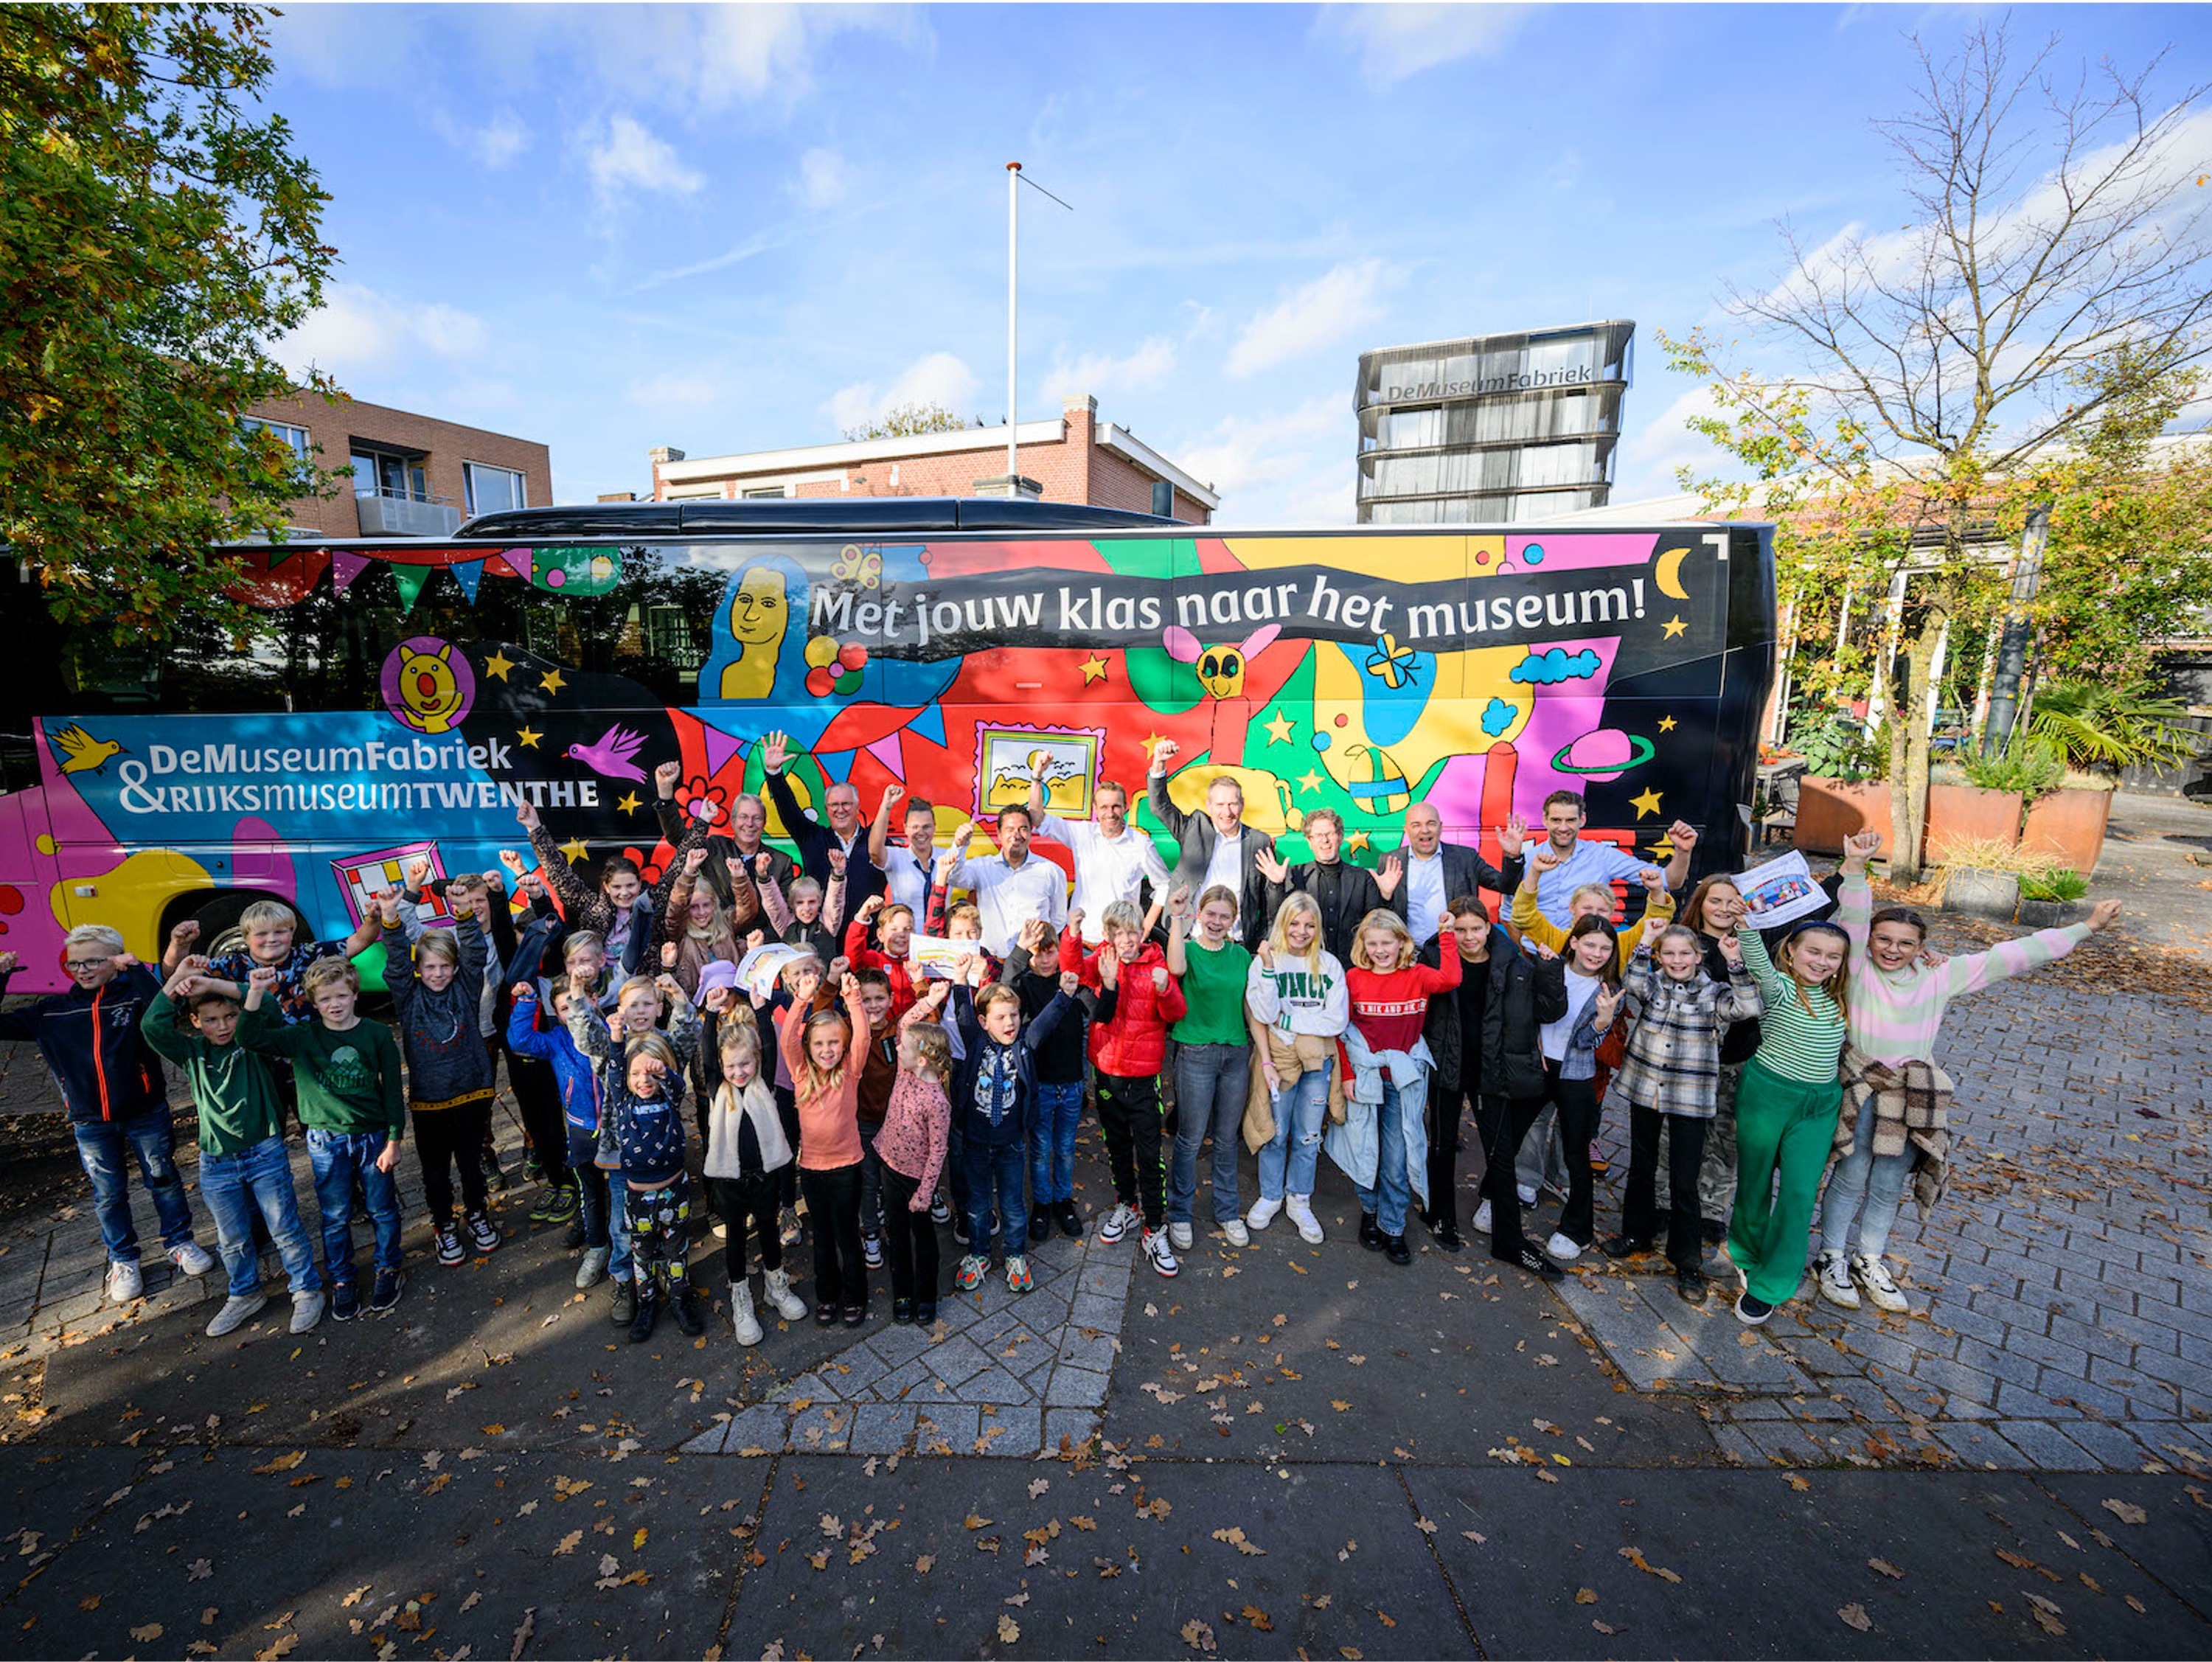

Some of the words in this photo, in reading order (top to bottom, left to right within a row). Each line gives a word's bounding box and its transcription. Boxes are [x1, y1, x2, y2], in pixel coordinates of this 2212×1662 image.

[1388, 365, 1591, 400] DeMuseumFabriek
[812, 588, 904, 638] Met
[916, 591, 1043, 646] jouw
[1059, 586, 1161, 630] klas
[1177, 580, 1298, 627] naar
[1307, 575, 1393, 636] het
[1408, 578, 1646, 639] museum!
[150, 738, 512, 773] DeMuseumFabriek
